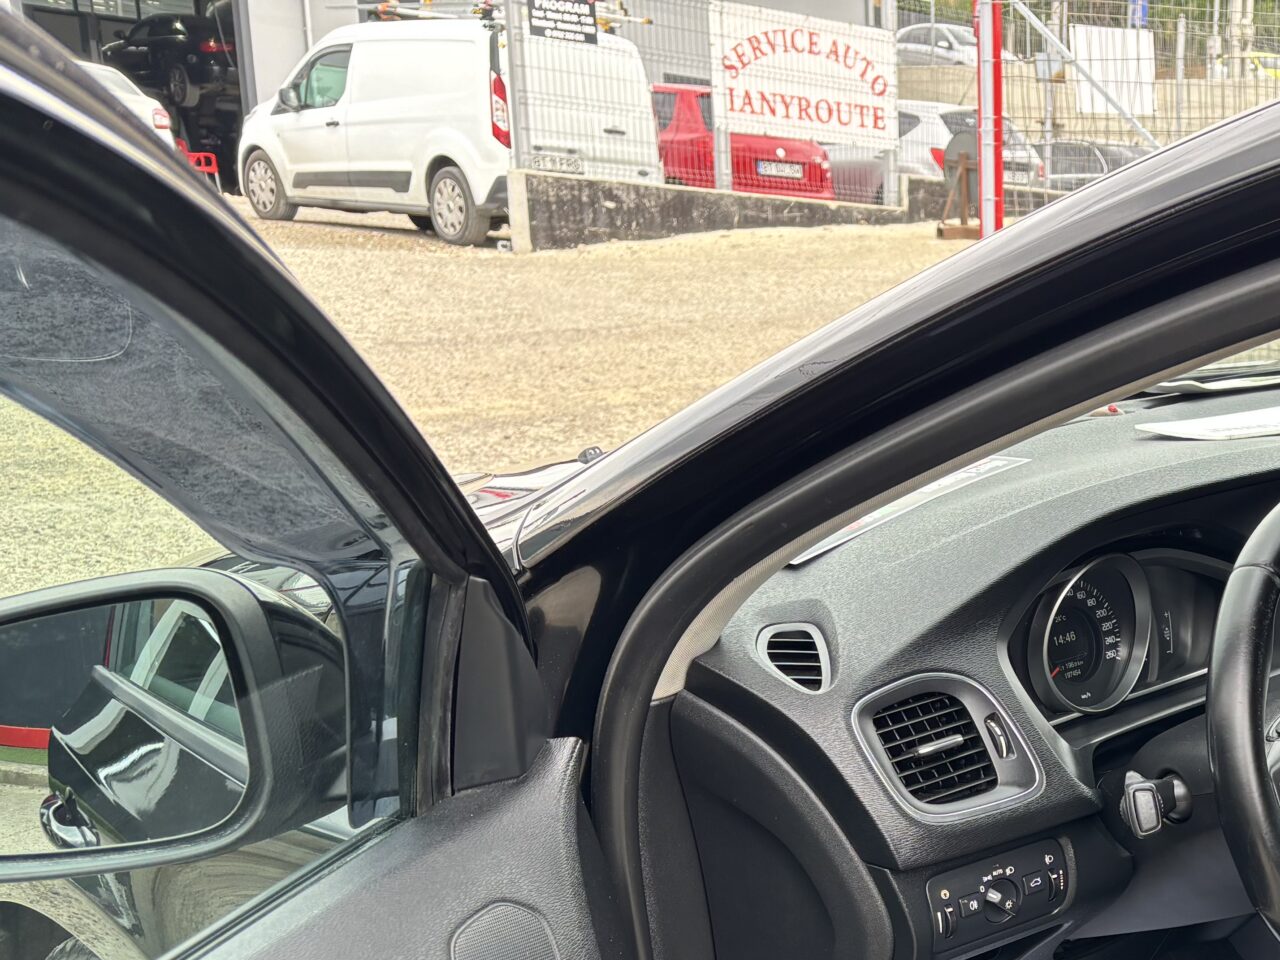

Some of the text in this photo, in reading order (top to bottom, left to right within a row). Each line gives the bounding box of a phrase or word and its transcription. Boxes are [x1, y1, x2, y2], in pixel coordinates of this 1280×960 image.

[721, 28, 889, 98] SERVICE AUTO
[1096, 609, 1107, 618] 200
[1101, 622, 1113, 631] 220
[1054, 631, 1076, 646] 14:46
[1104, 635, 1116, 645] 240
